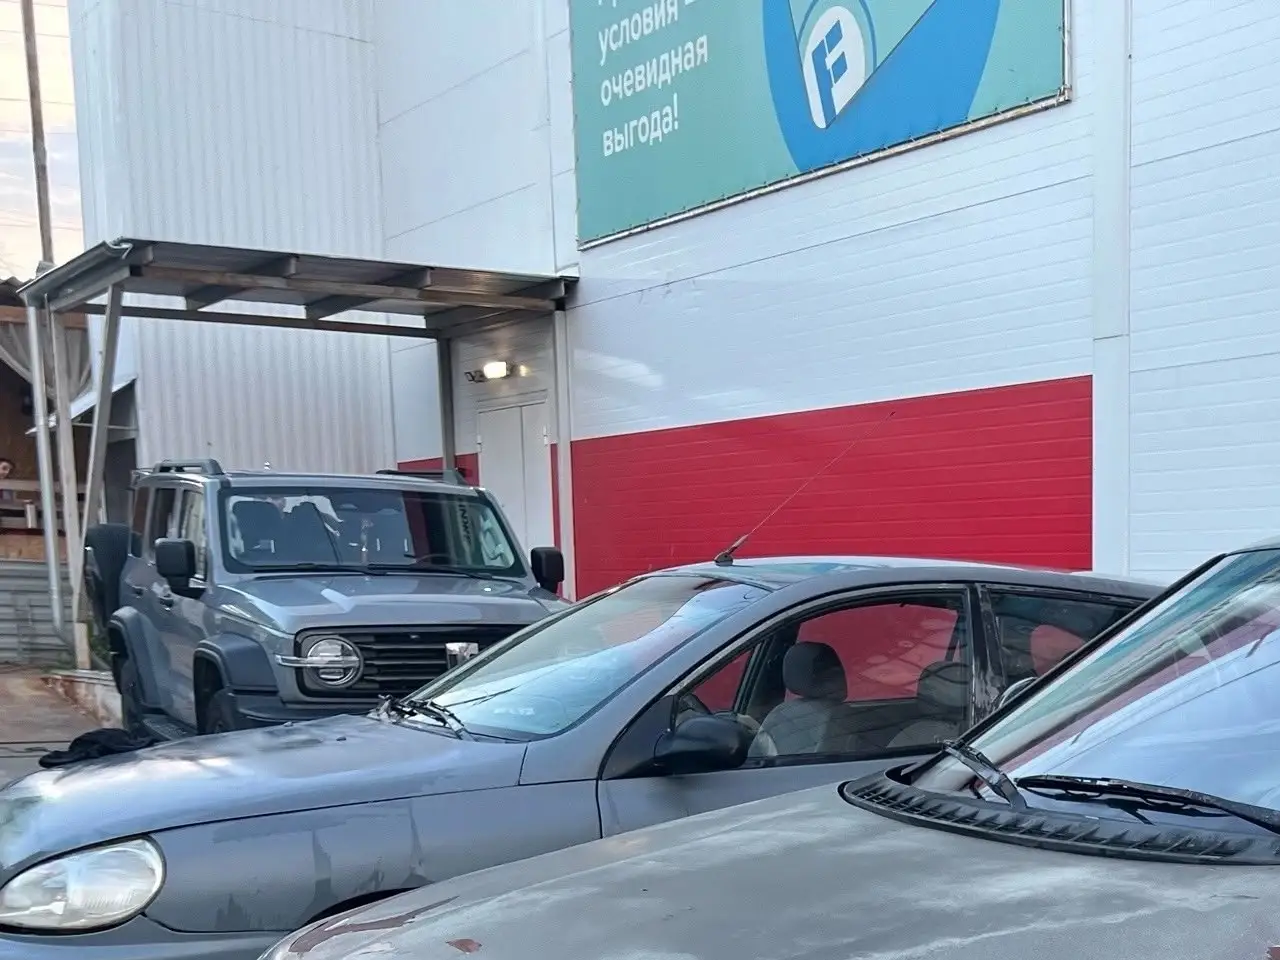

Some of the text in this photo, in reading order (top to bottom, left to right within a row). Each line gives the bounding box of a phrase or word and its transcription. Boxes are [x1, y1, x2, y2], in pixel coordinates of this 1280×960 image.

[598, 0, 678, 65] условия
[600, 35, 708, 107] очевидная
[603, 92, 680, 157] выгода!
